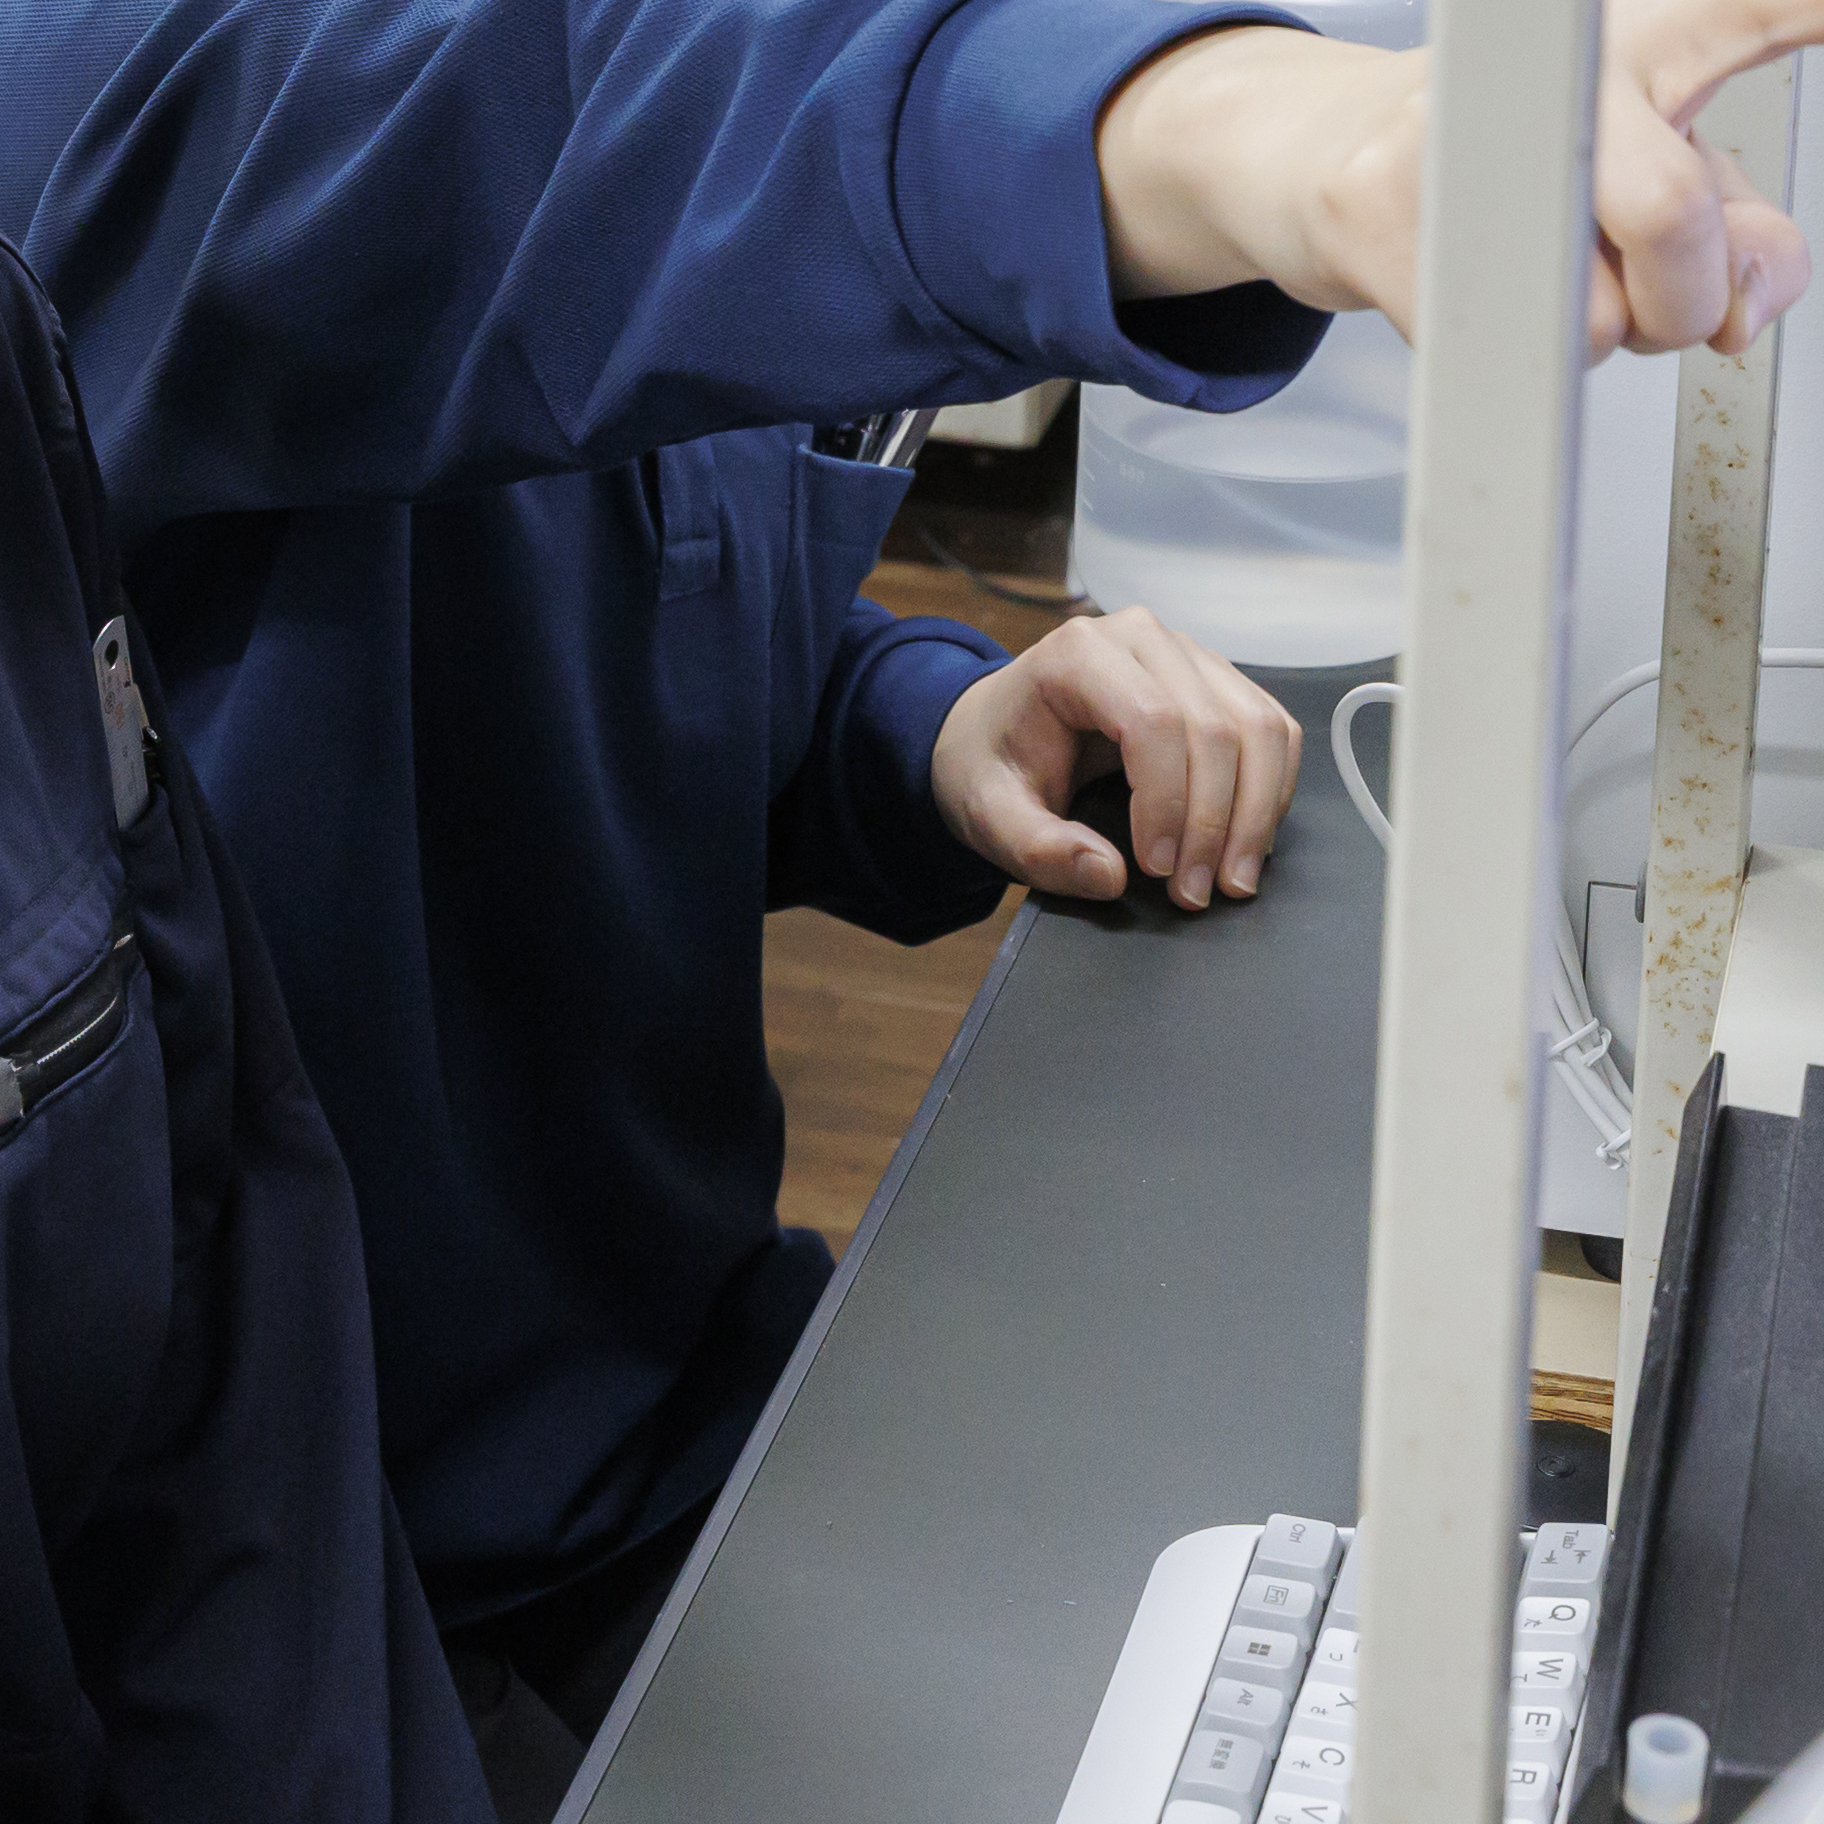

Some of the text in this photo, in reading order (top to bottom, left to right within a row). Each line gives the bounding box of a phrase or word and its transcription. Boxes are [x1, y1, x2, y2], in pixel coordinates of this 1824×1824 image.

[1288, 1523, 1306, 1544] Ctrl
[1562, 1530, 1579, 1550] Tab
[1550, 1604, 1576, 1622] Q
[1536, 1657, 1564, 1681] W
[1237, 1688, 1254, 1706] Alt
[1525, 1711, 1551, 1727] E
[1511, 1767, 1536, 1786] R
